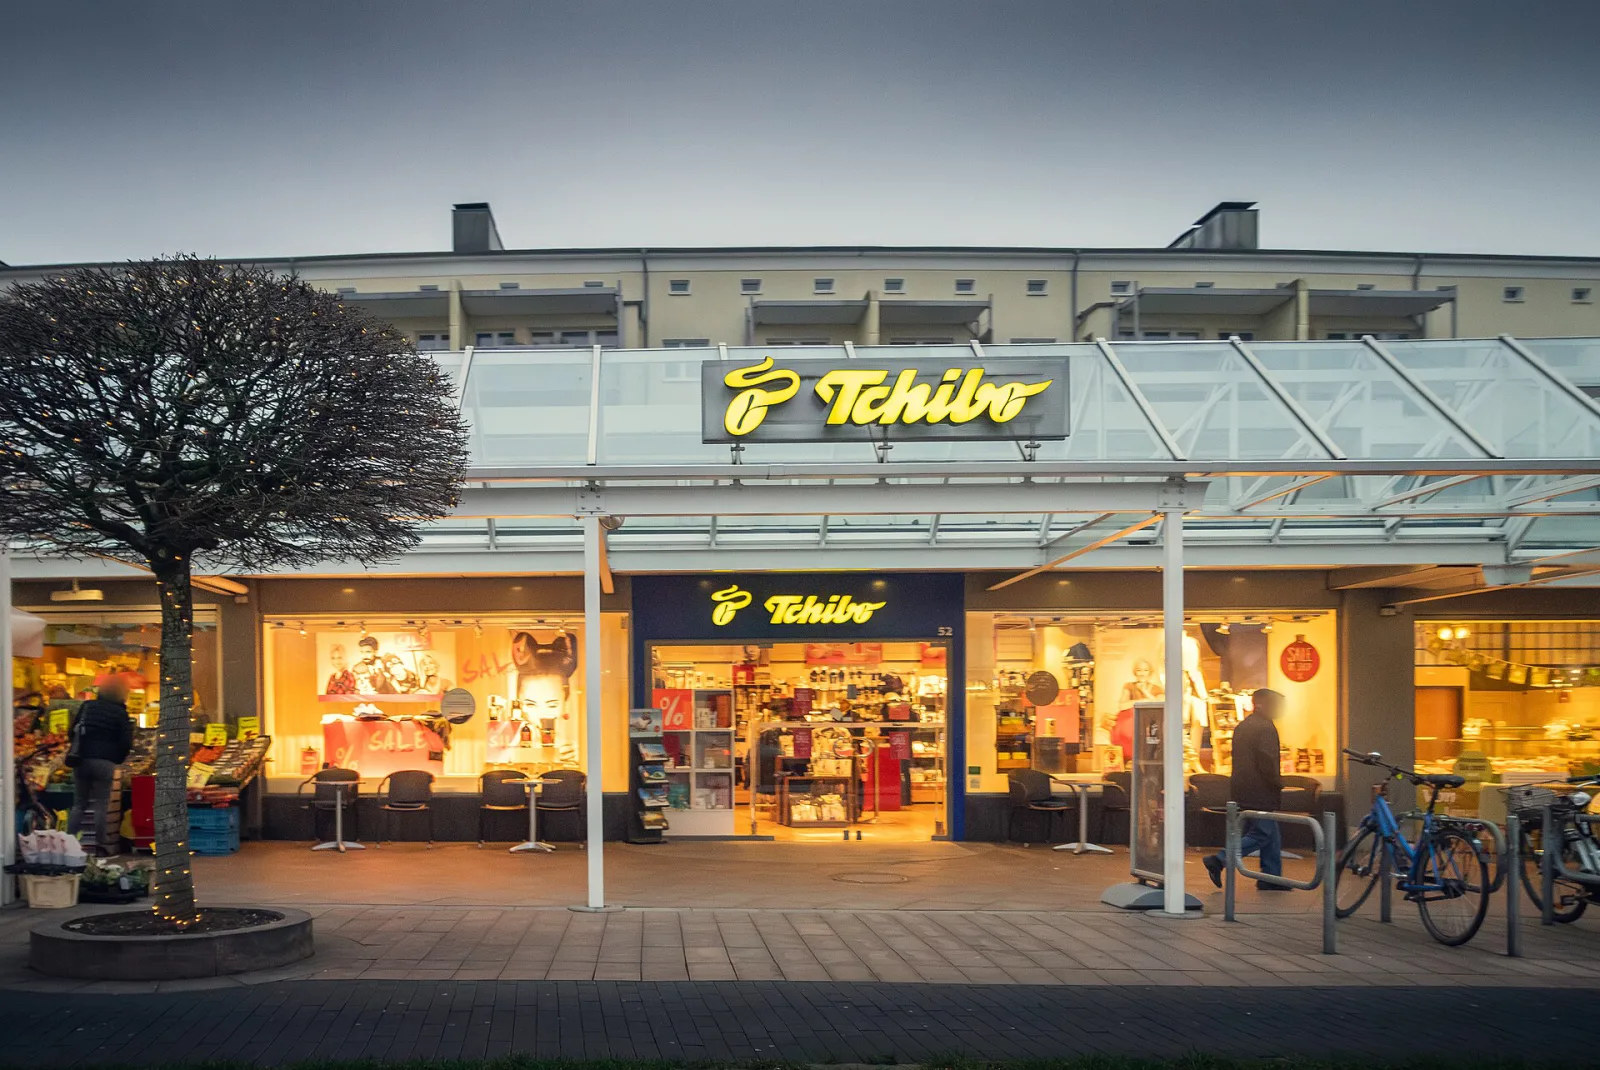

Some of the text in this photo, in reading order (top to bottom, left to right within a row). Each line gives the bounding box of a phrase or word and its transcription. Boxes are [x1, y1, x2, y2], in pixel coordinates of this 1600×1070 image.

[814, 368, 1053, 425] Tchibo
[764, 595, 887, 624] Tchibo
[937, 626, 953, 636] 52
[368, 730, 427, 751] SALE
